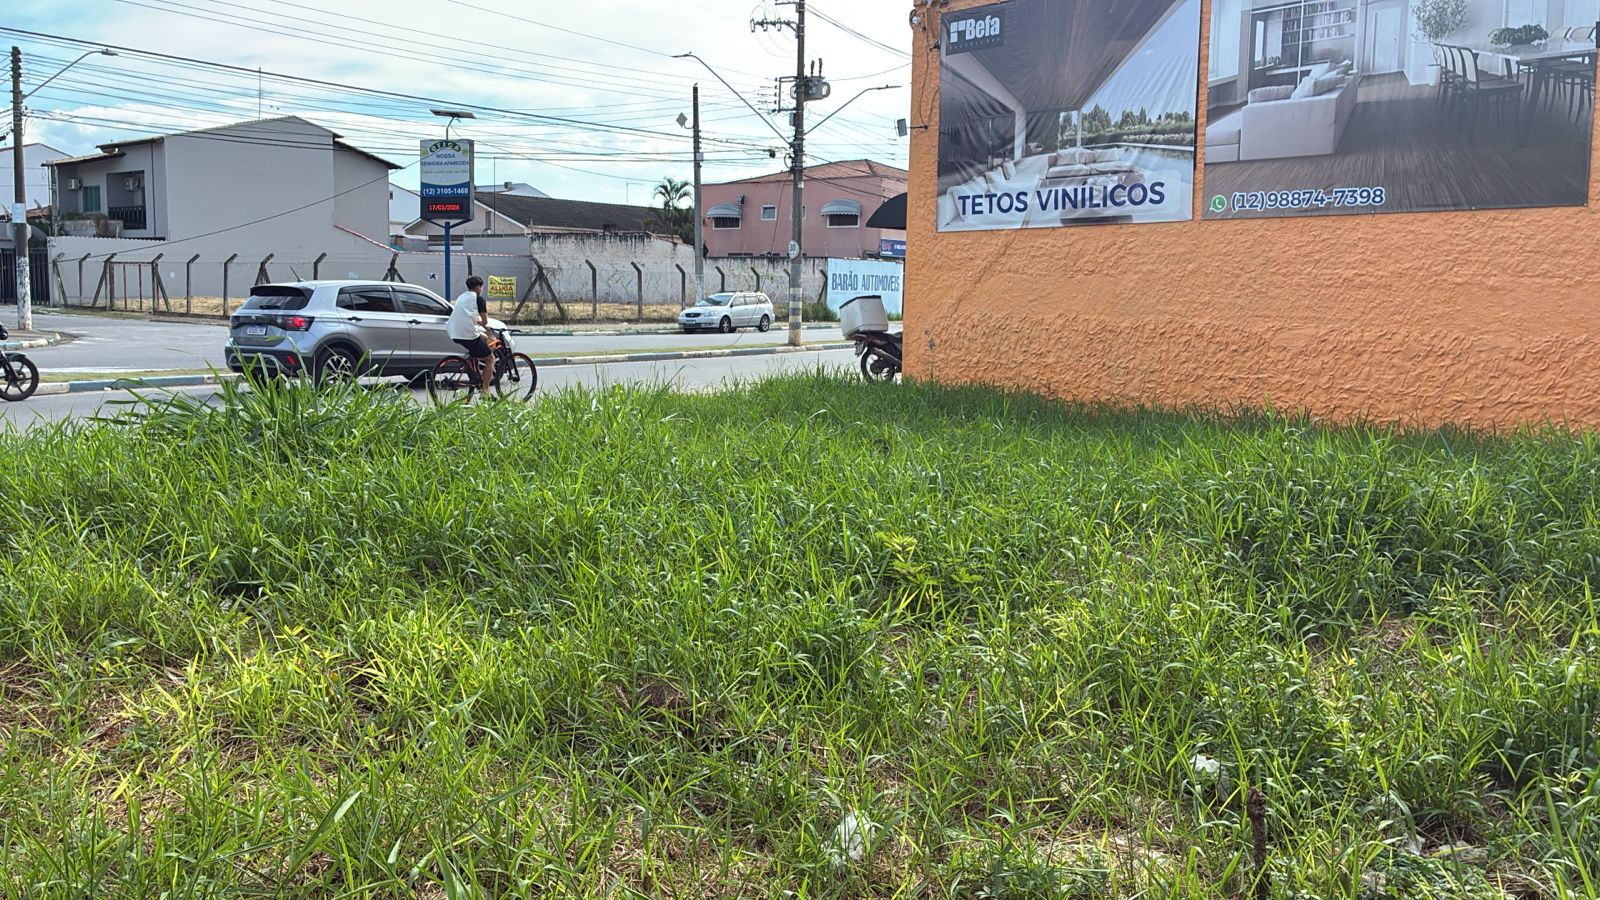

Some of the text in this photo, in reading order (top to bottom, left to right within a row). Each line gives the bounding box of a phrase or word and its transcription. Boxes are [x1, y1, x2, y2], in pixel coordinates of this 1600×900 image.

[965, 15, 1000, 40] Befa
[423, 187, 469, 196] (12) 3105-1469
[958, 181, 1165, 215] TETOS VINÍLICOS
[832, 271, 858, 291] BARÃO
